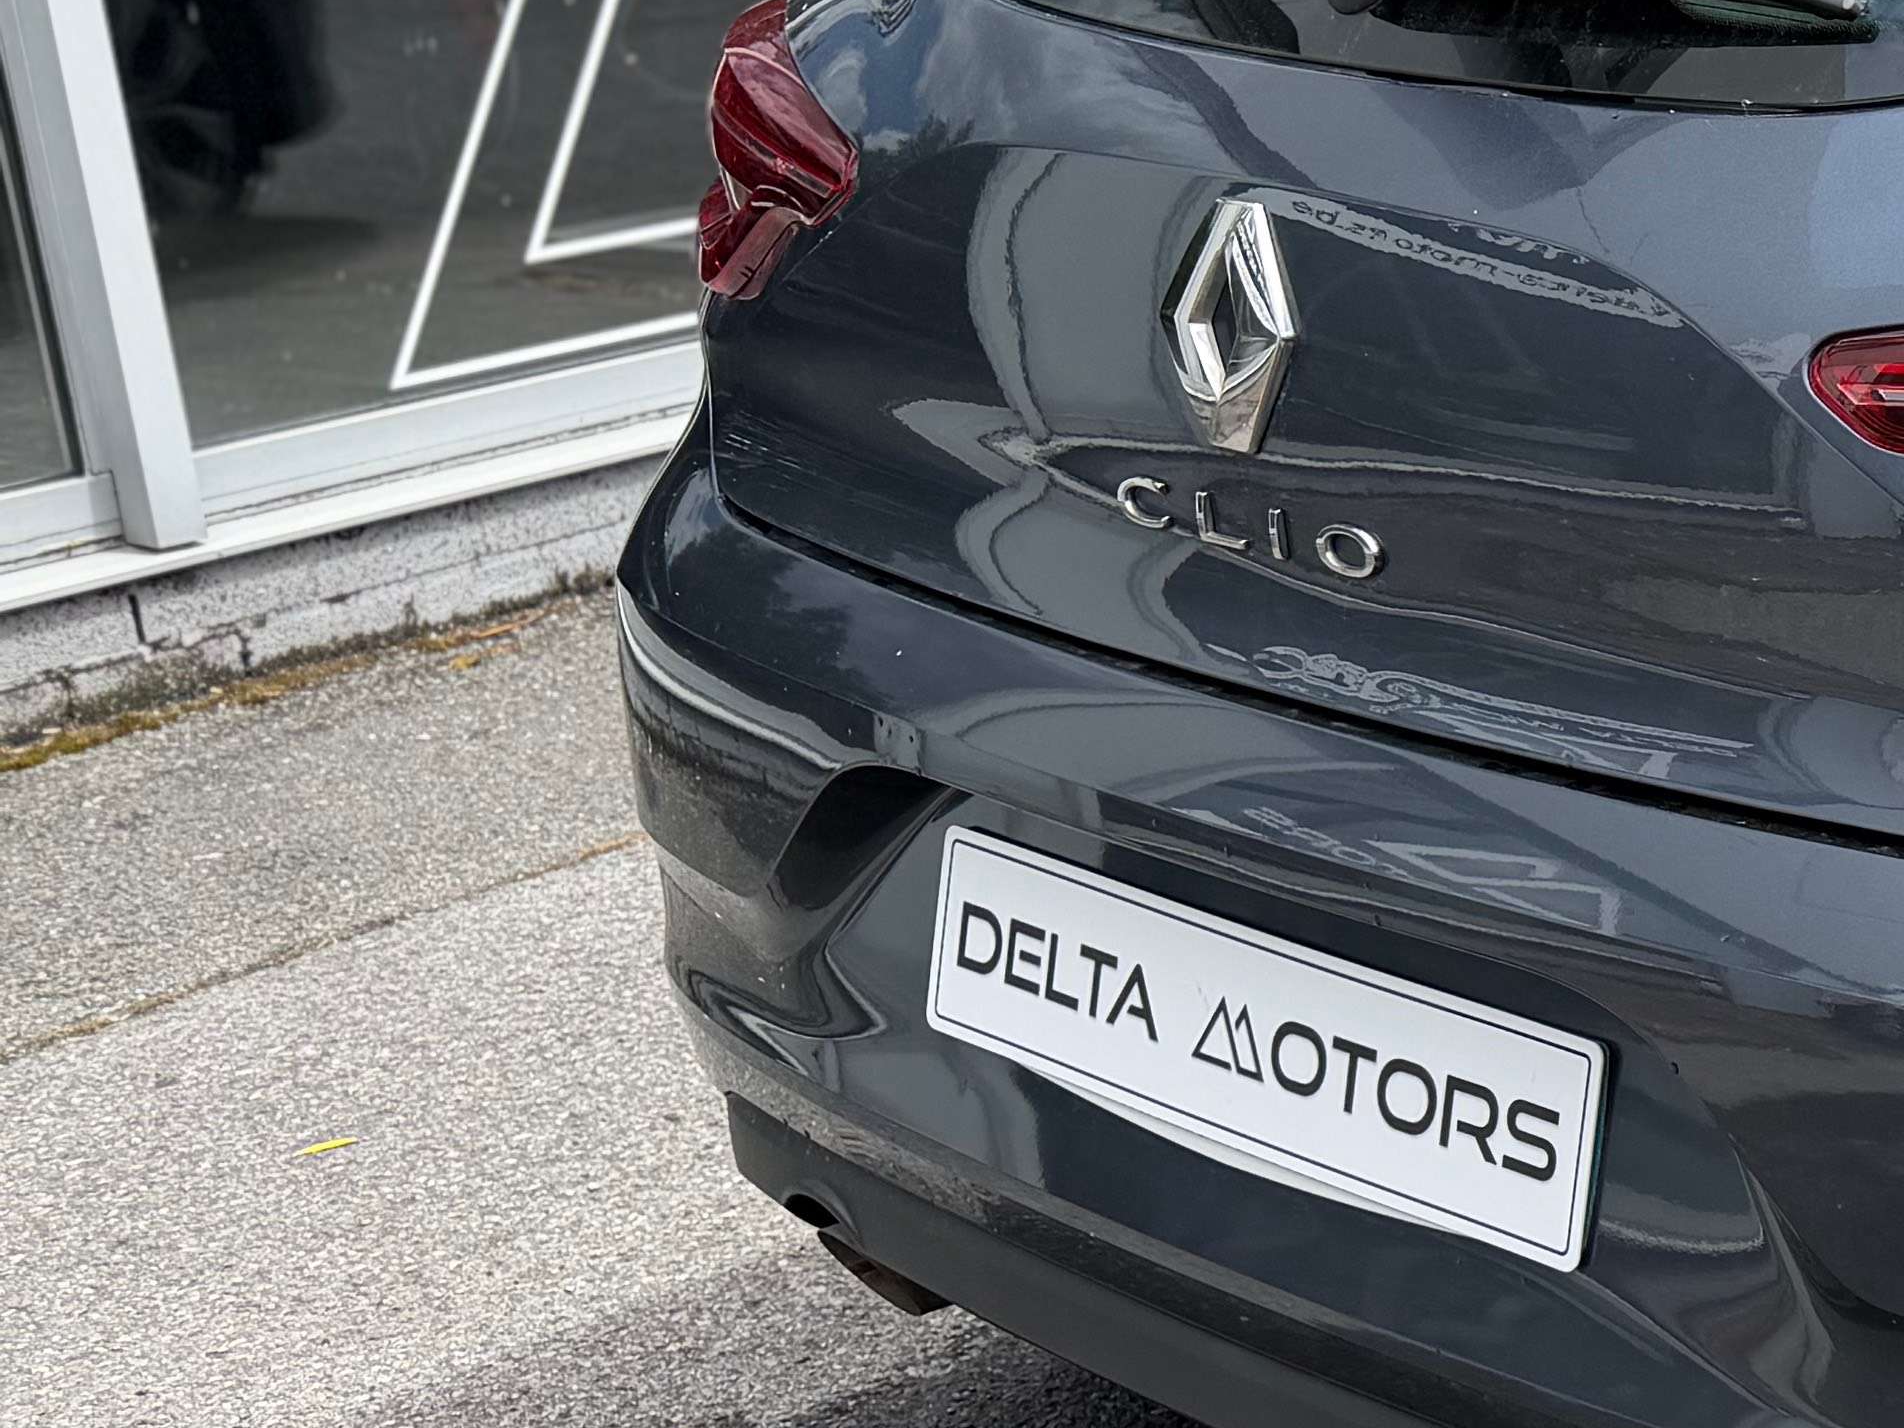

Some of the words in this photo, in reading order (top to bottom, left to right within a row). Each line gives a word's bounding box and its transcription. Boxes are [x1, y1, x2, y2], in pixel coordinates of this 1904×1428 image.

[1116, 475, 1386, 579] CLIO
[955, 900, 1160, 1043] DELTA
[1190, 993, 1561, 1182] MOTORS
